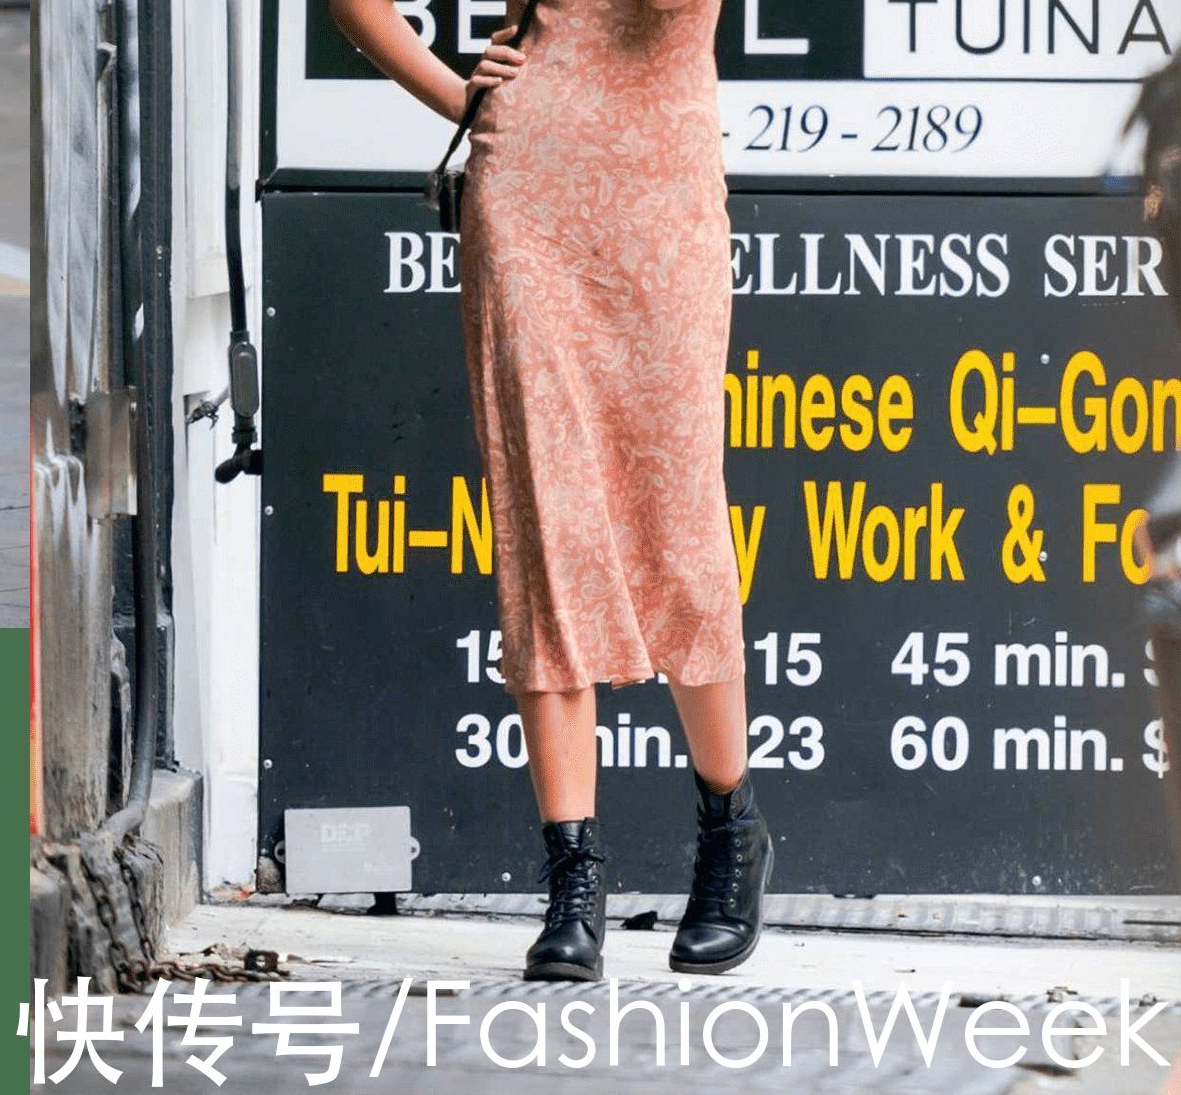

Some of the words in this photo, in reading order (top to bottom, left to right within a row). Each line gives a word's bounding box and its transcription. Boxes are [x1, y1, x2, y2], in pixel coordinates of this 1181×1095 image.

[743, 105, 829, 153] 219
[870, 105, 983, 153] 2189
[729, 233, 1010, 298] ELLNESS
[1044, 234, 1169, 298] SER
[803, 481, 965, 583] Work
[1002, 484, 1046, 584] &
[891, 632, 970, 687] 45
[994, 631, 1125, 687] min.
[455, 713, 529, 768] 30
[748, 714, 825, 771] 23
[890, 716, 970, 770] 60
[993, 715, 1124, 771] min.
